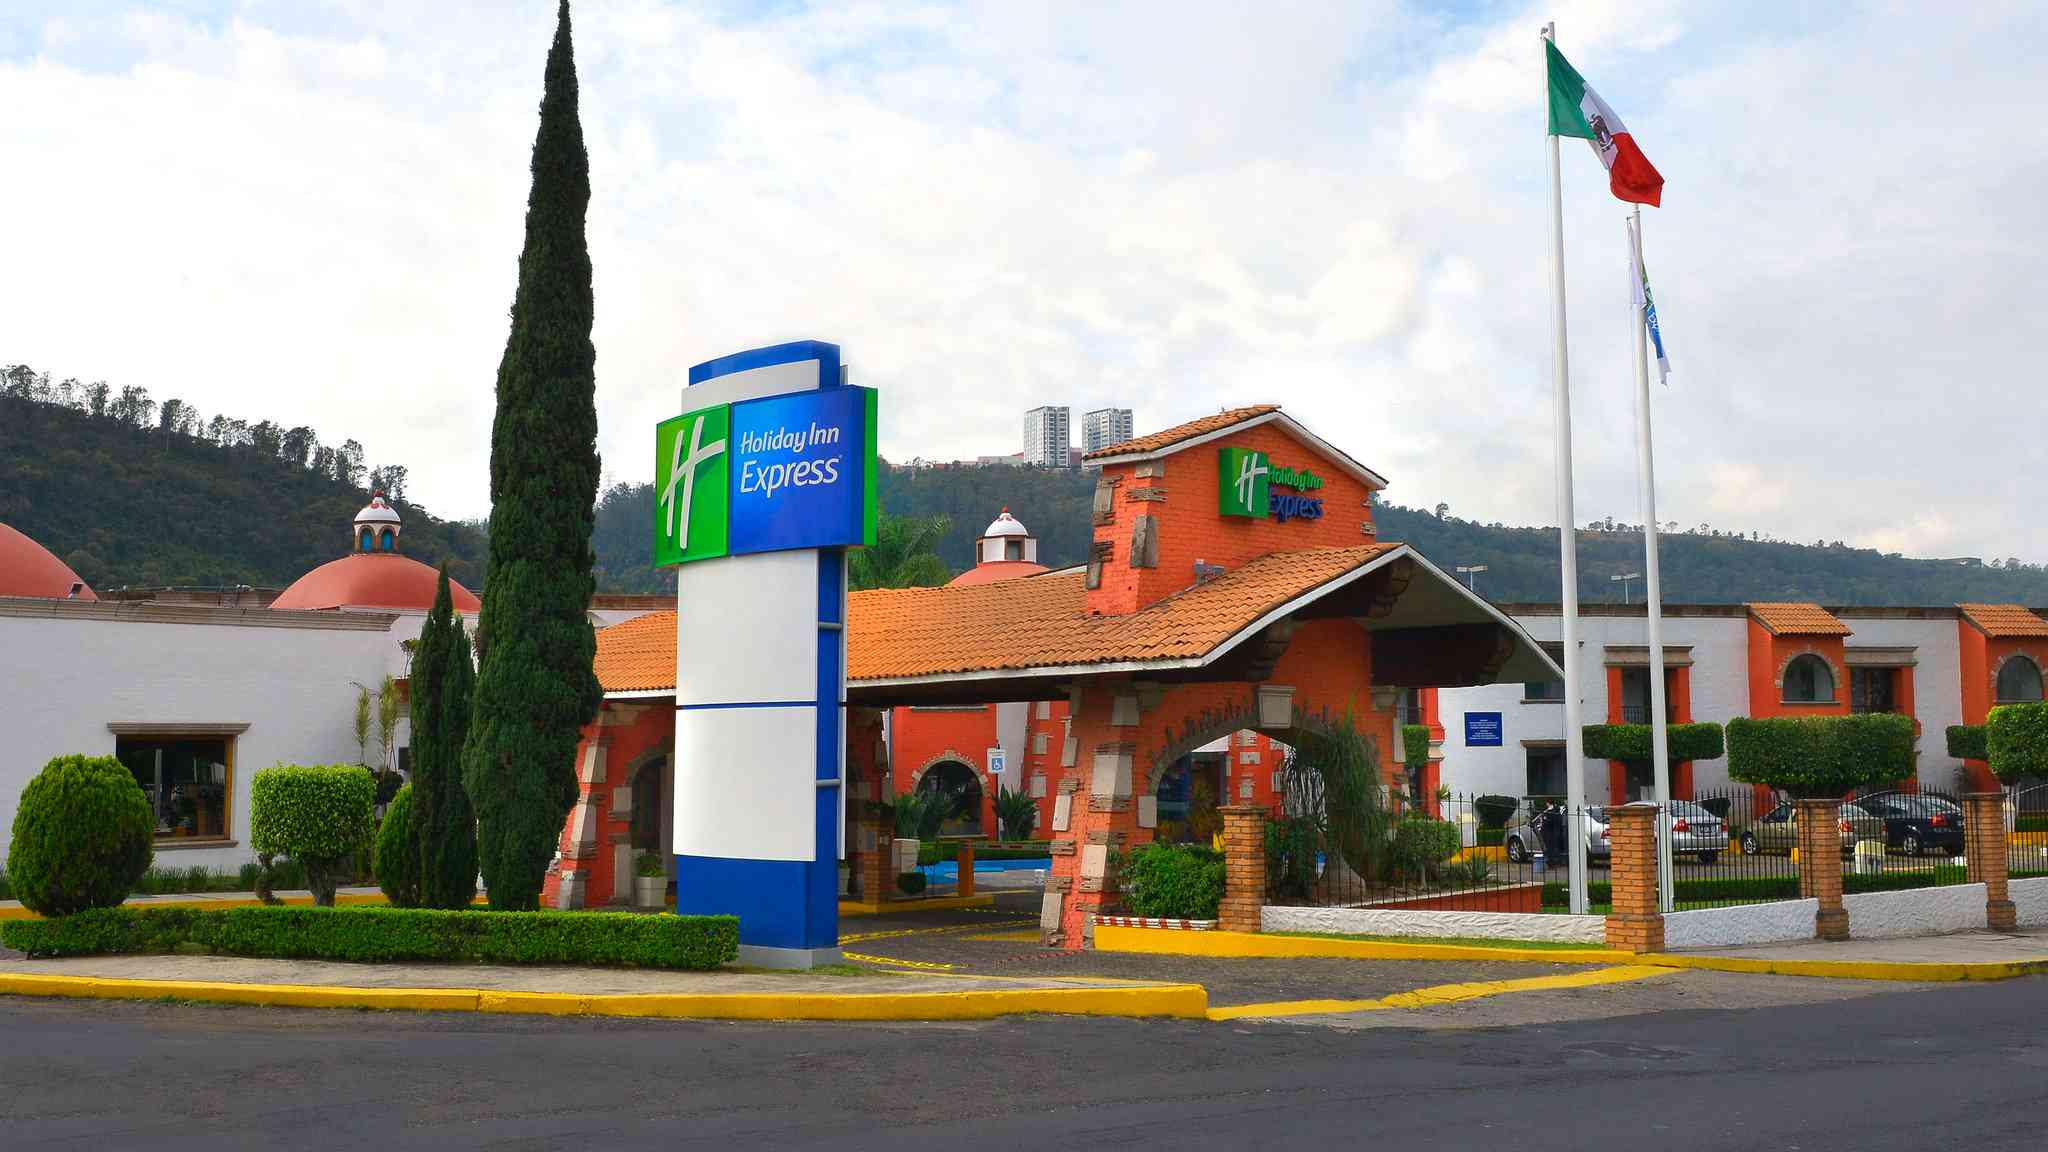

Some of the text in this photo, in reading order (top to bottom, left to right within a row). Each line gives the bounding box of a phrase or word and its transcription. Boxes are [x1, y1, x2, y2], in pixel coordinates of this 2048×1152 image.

[740, 421, 840, 455] Holiday Inn
[740, 457, 840, 498] Express
[1267, 463, 1306, 492] Holiday
